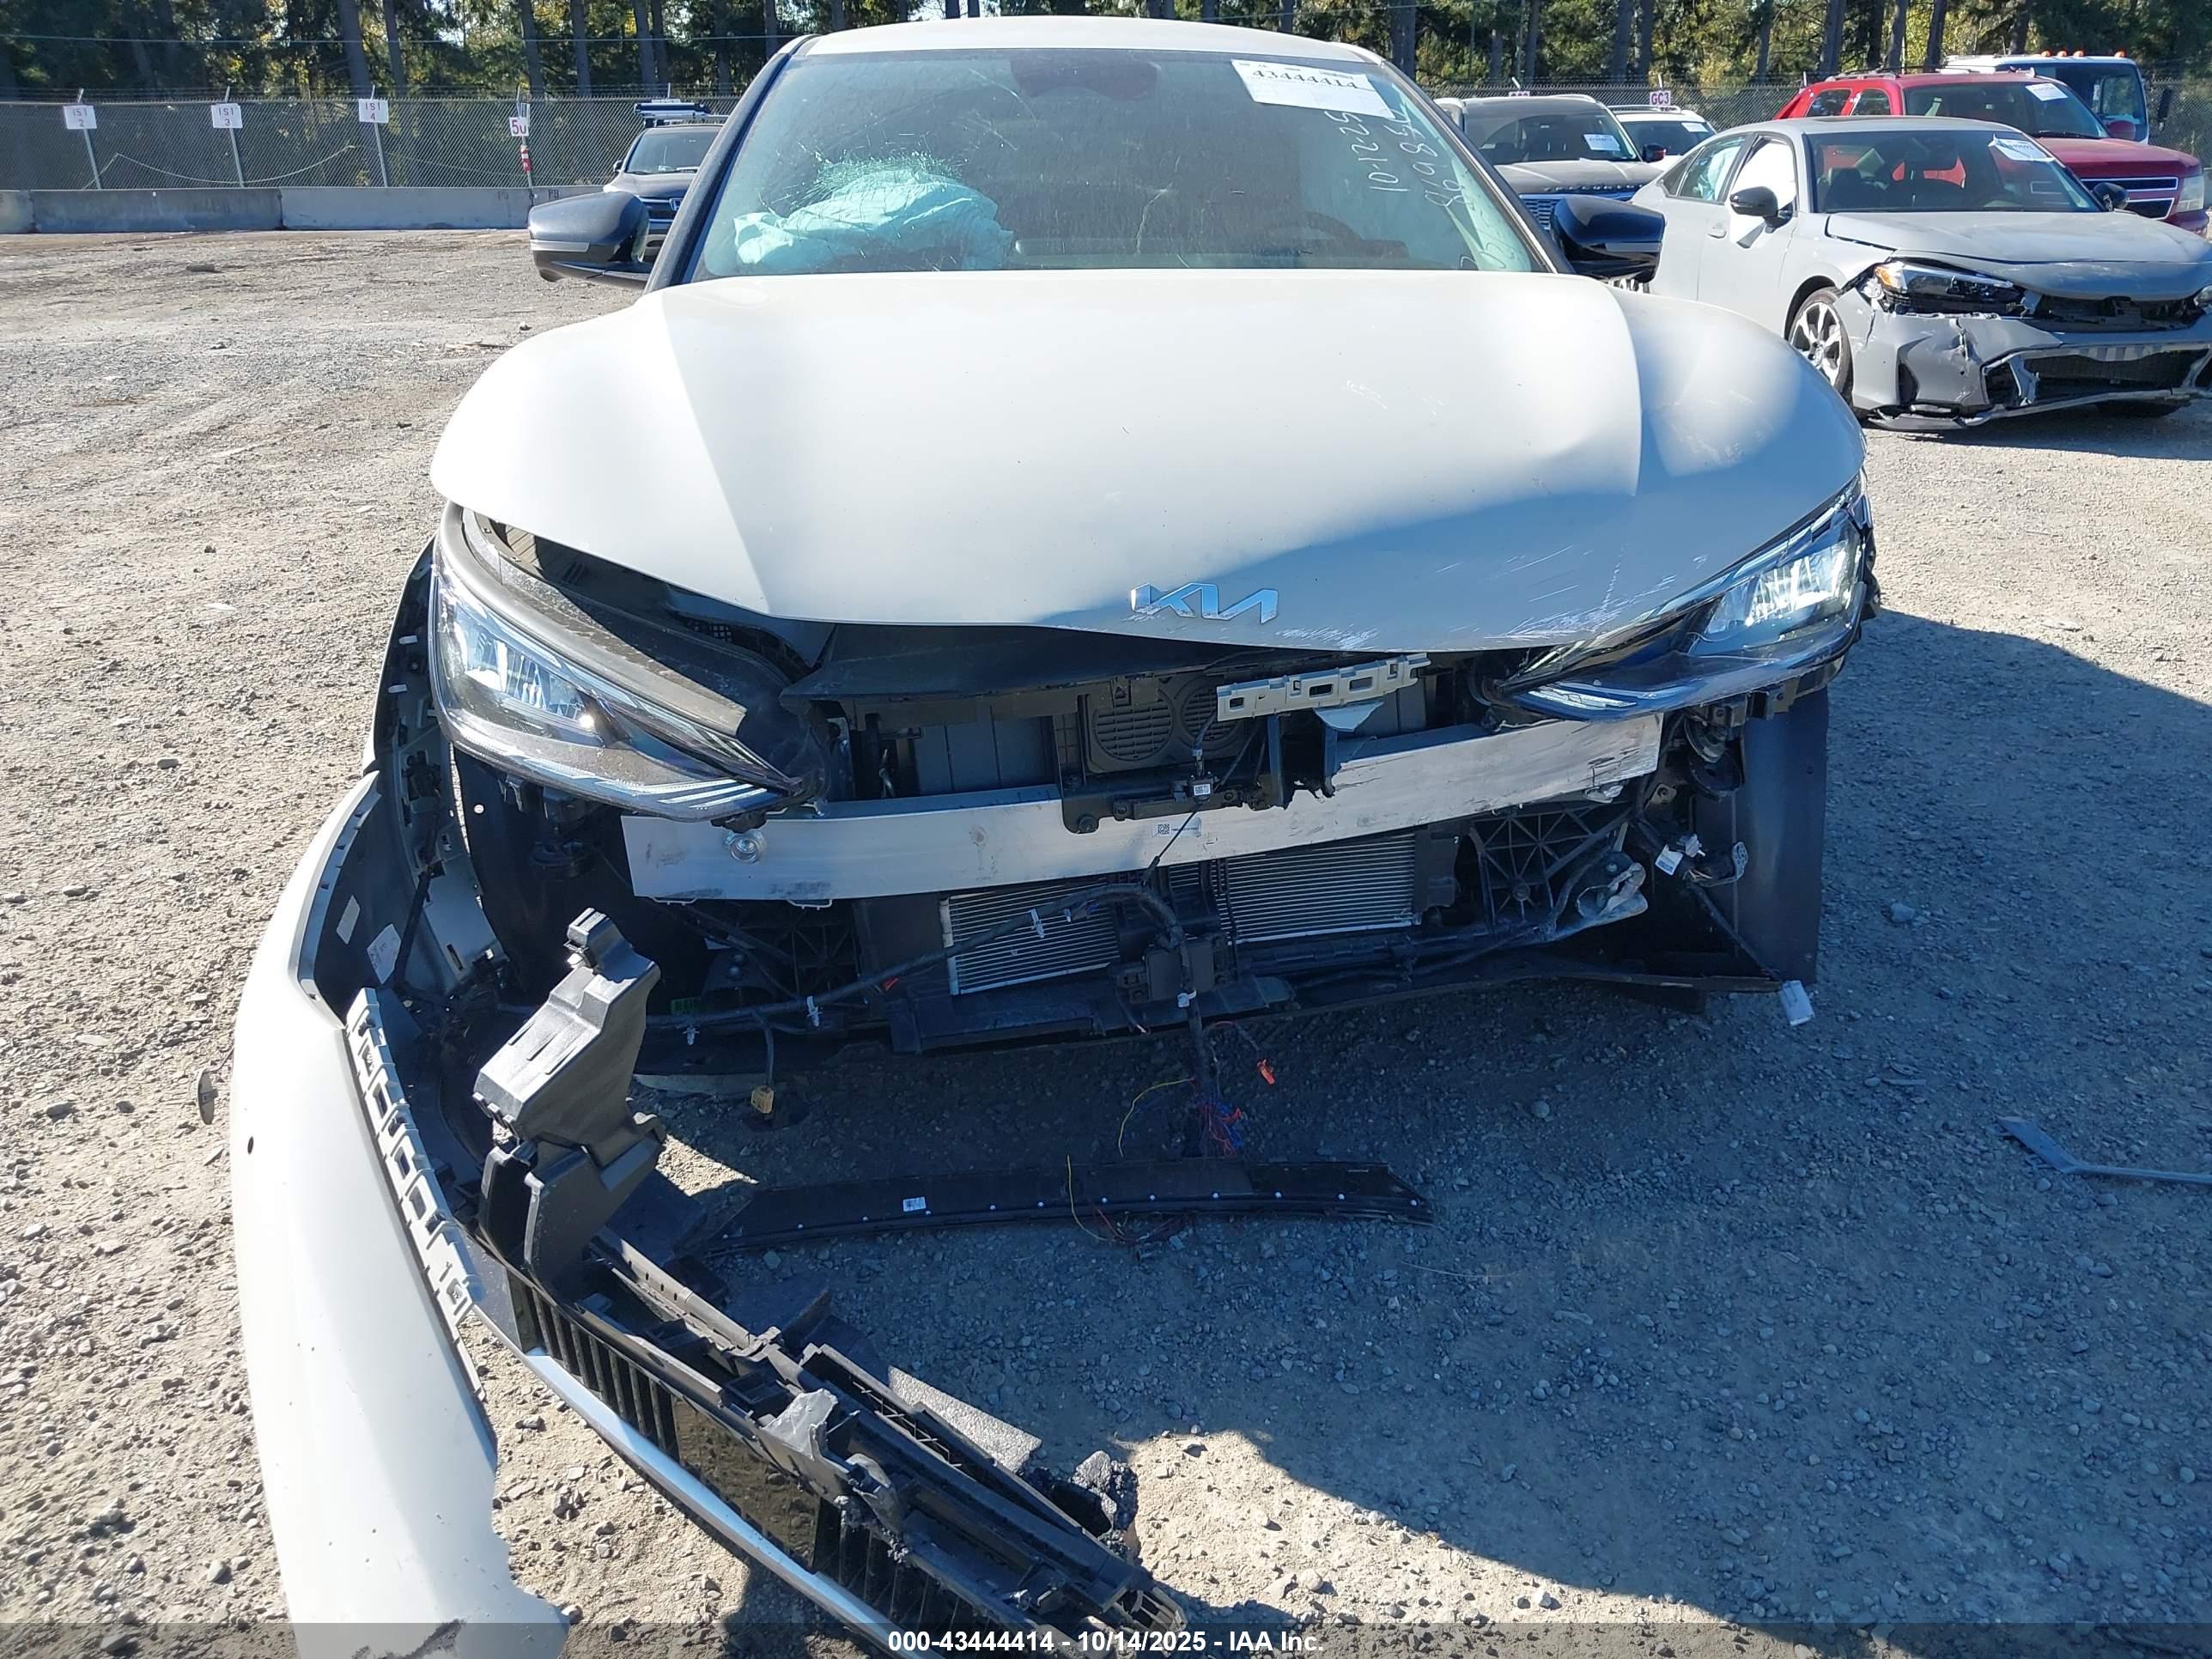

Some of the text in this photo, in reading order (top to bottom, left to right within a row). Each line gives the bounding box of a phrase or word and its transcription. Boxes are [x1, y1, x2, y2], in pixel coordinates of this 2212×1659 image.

[1252, 69, 1358, 89] 43444414
[1650, 92, 1669, 105] GC3
[370, 112, 376, 121] 4
[78, 118, 85, 128] 2
[224, 118, 231, 127] 3
[1323, 110, 1410, 193] 10-12-25
